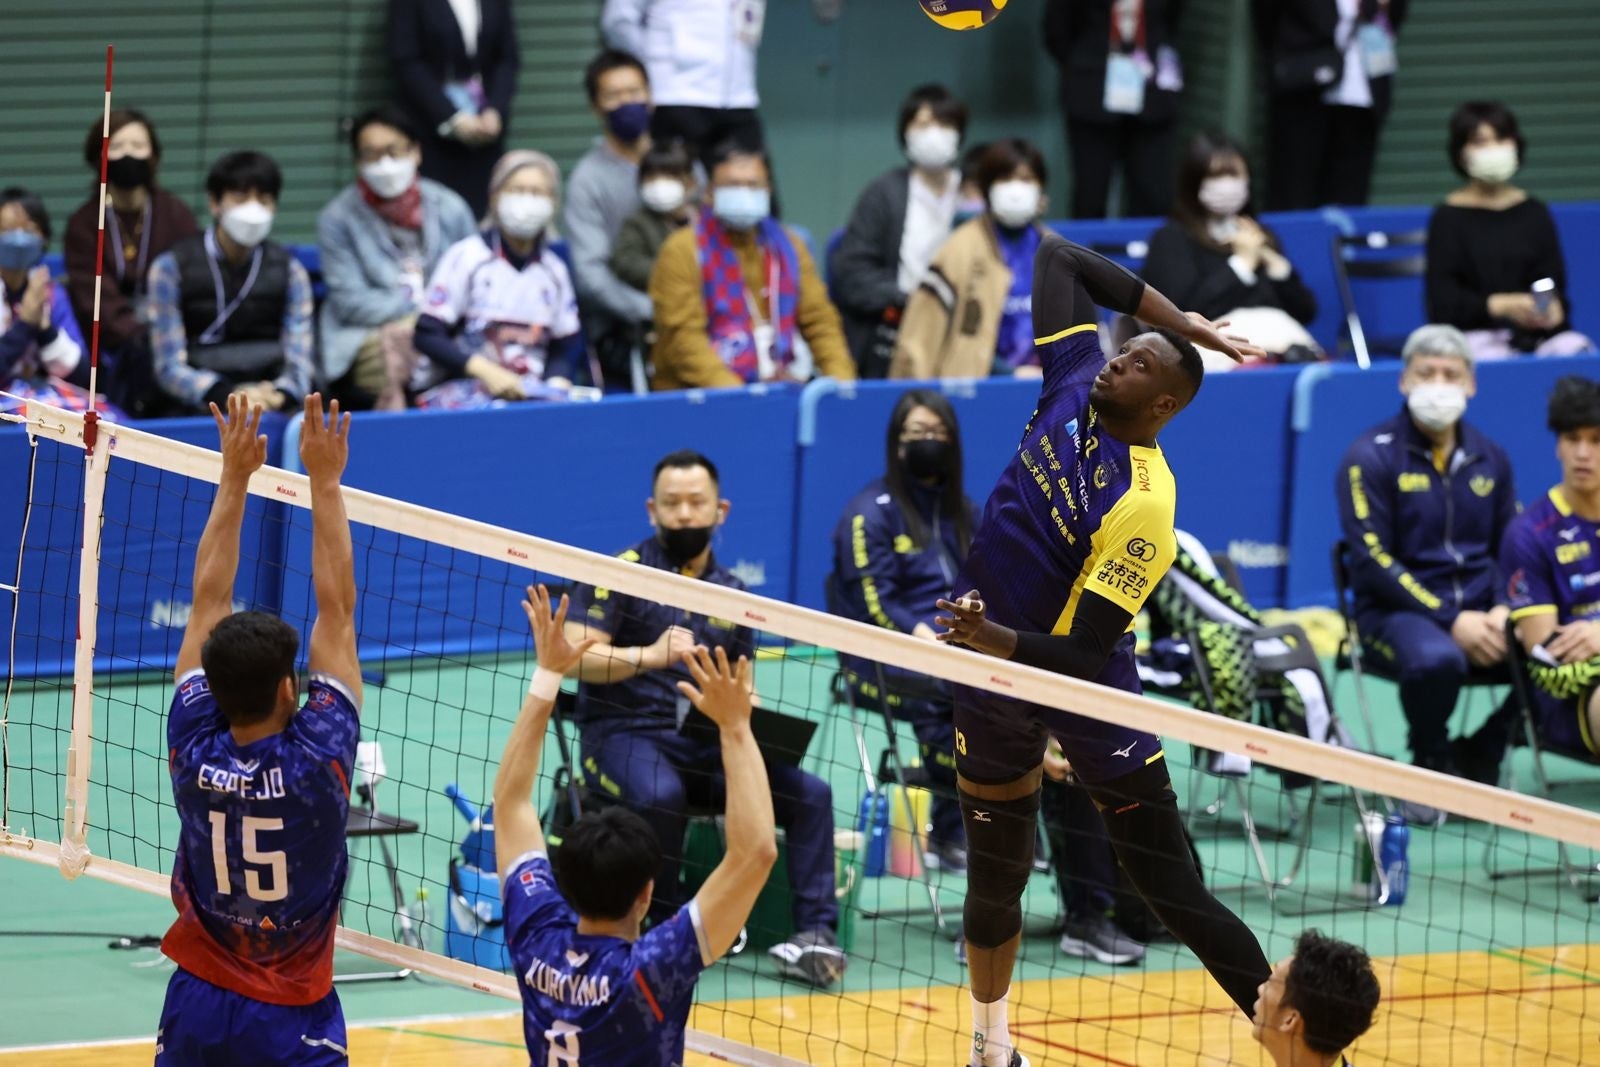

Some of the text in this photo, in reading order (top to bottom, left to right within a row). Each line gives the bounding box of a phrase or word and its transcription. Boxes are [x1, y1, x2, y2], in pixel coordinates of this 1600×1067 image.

[1040, 435, 1061, 471] 甲南大学
[1133, 456, 1151, 492] J:COM
[1058, 477, 1077, 520] SANK
[1097, 570, 1142, 599] せいてつ
[1104, 559, 1149, 589] おおさか
[955, 727, 967, 756] 13
[198, 763, 286, 800] ESPEJO
[208, 810, 289, 902] 15
